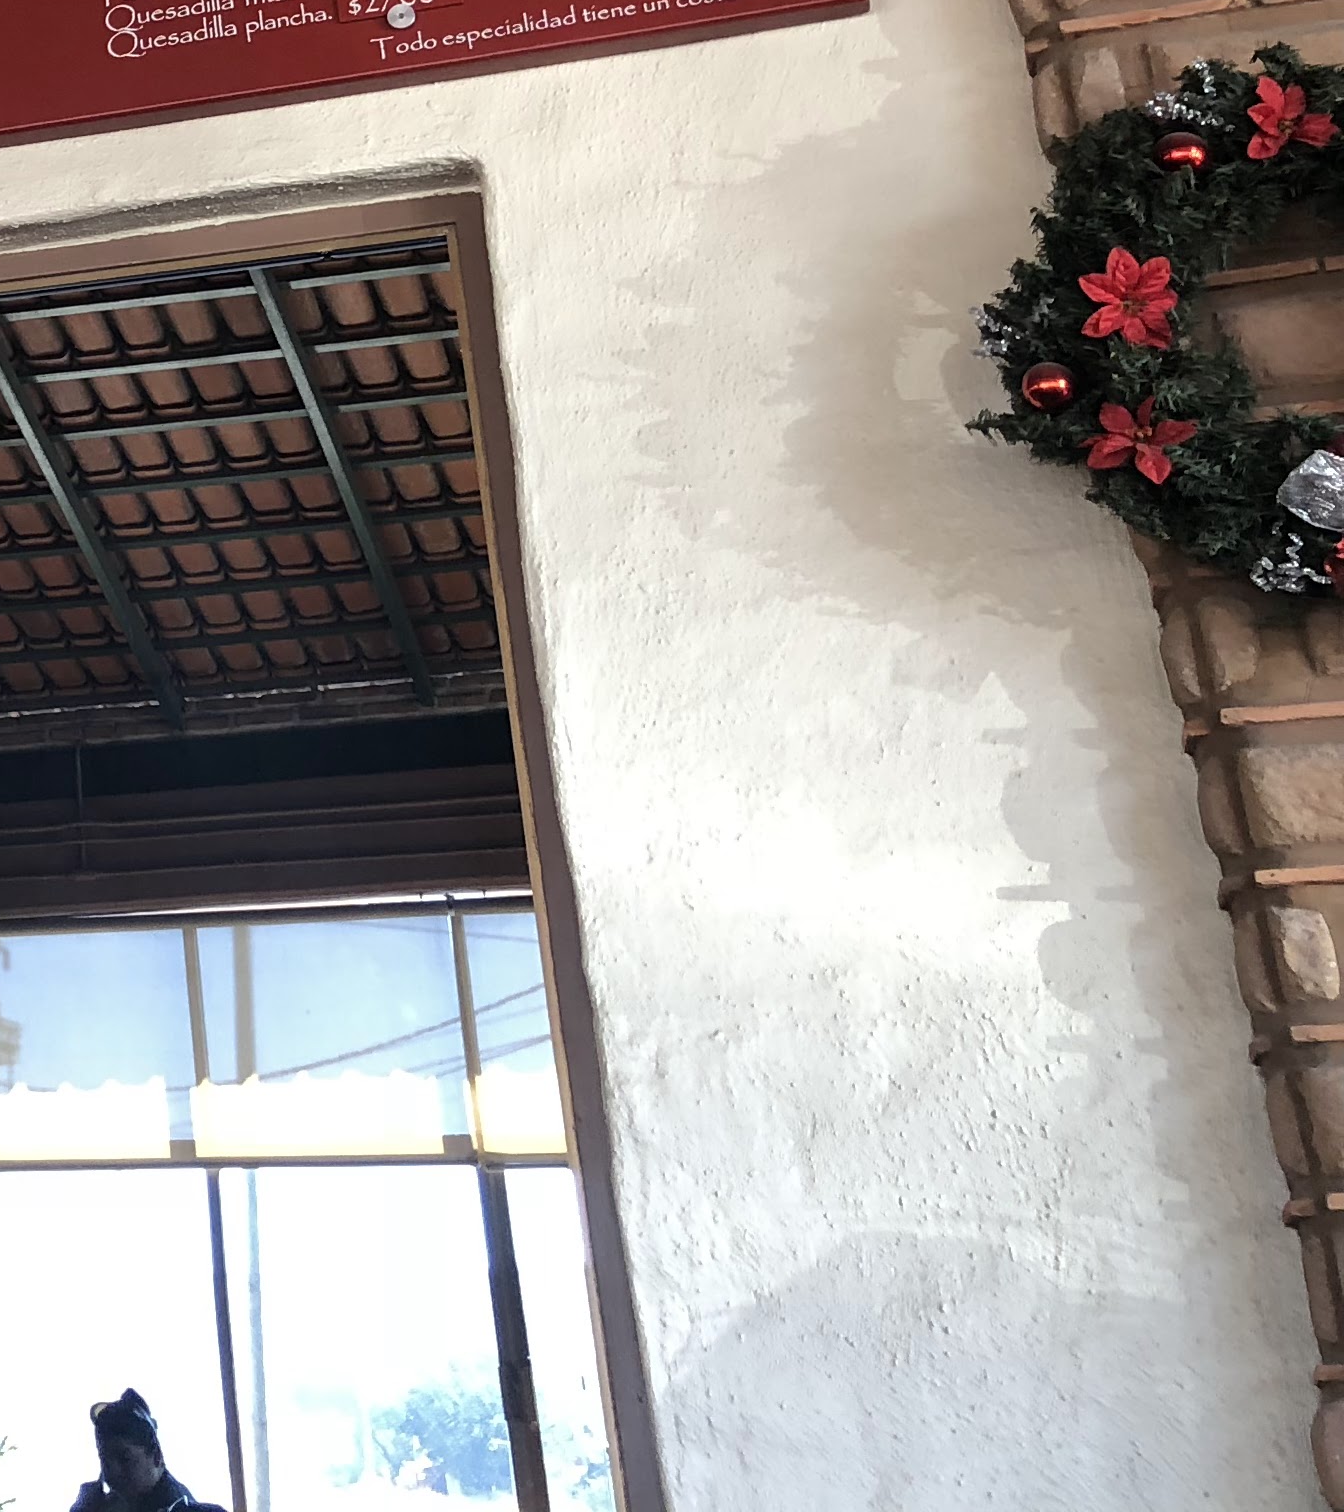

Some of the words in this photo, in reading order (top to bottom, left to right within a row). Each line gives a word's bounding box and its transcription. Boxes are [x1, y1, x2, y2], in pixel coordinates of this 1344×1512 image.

[105, 11, 237, 57] Quesadilla
[370, 34, 437, 59] Todo
[442, 5, 576, 49] especialidad
[582, 5, 636, 22] tiene
[643, 0, 670, 12] un
